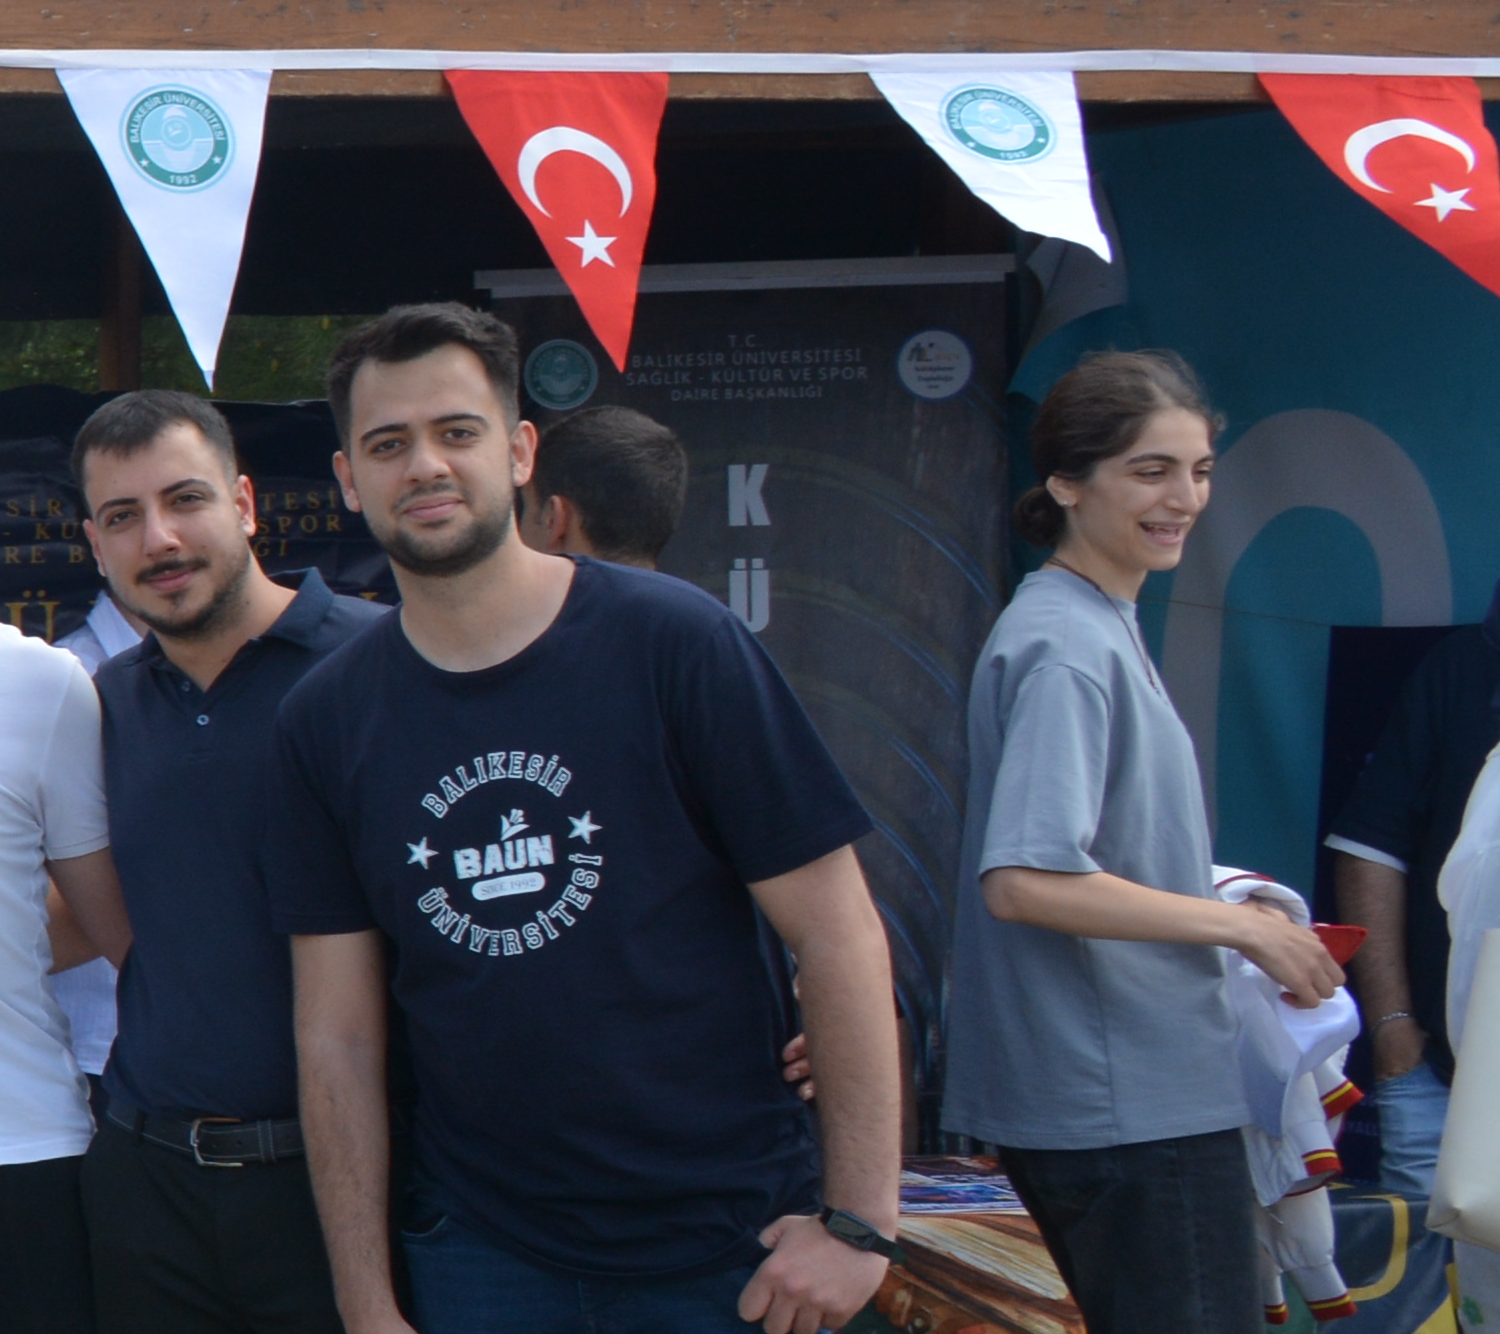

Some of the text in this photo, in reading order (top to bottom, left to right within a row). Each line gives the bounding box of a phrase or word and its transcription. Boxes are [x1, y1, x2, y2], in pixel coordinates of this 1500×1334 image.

[169, 174, 198, 185] 1992
[788, 367, 812, 382] VE
[817, 366, 869, 382] SPOR
[421, 751, 573, 819] BALIKESİR
[417, 852, 604, 956] ÜNİVERSİTESİ
